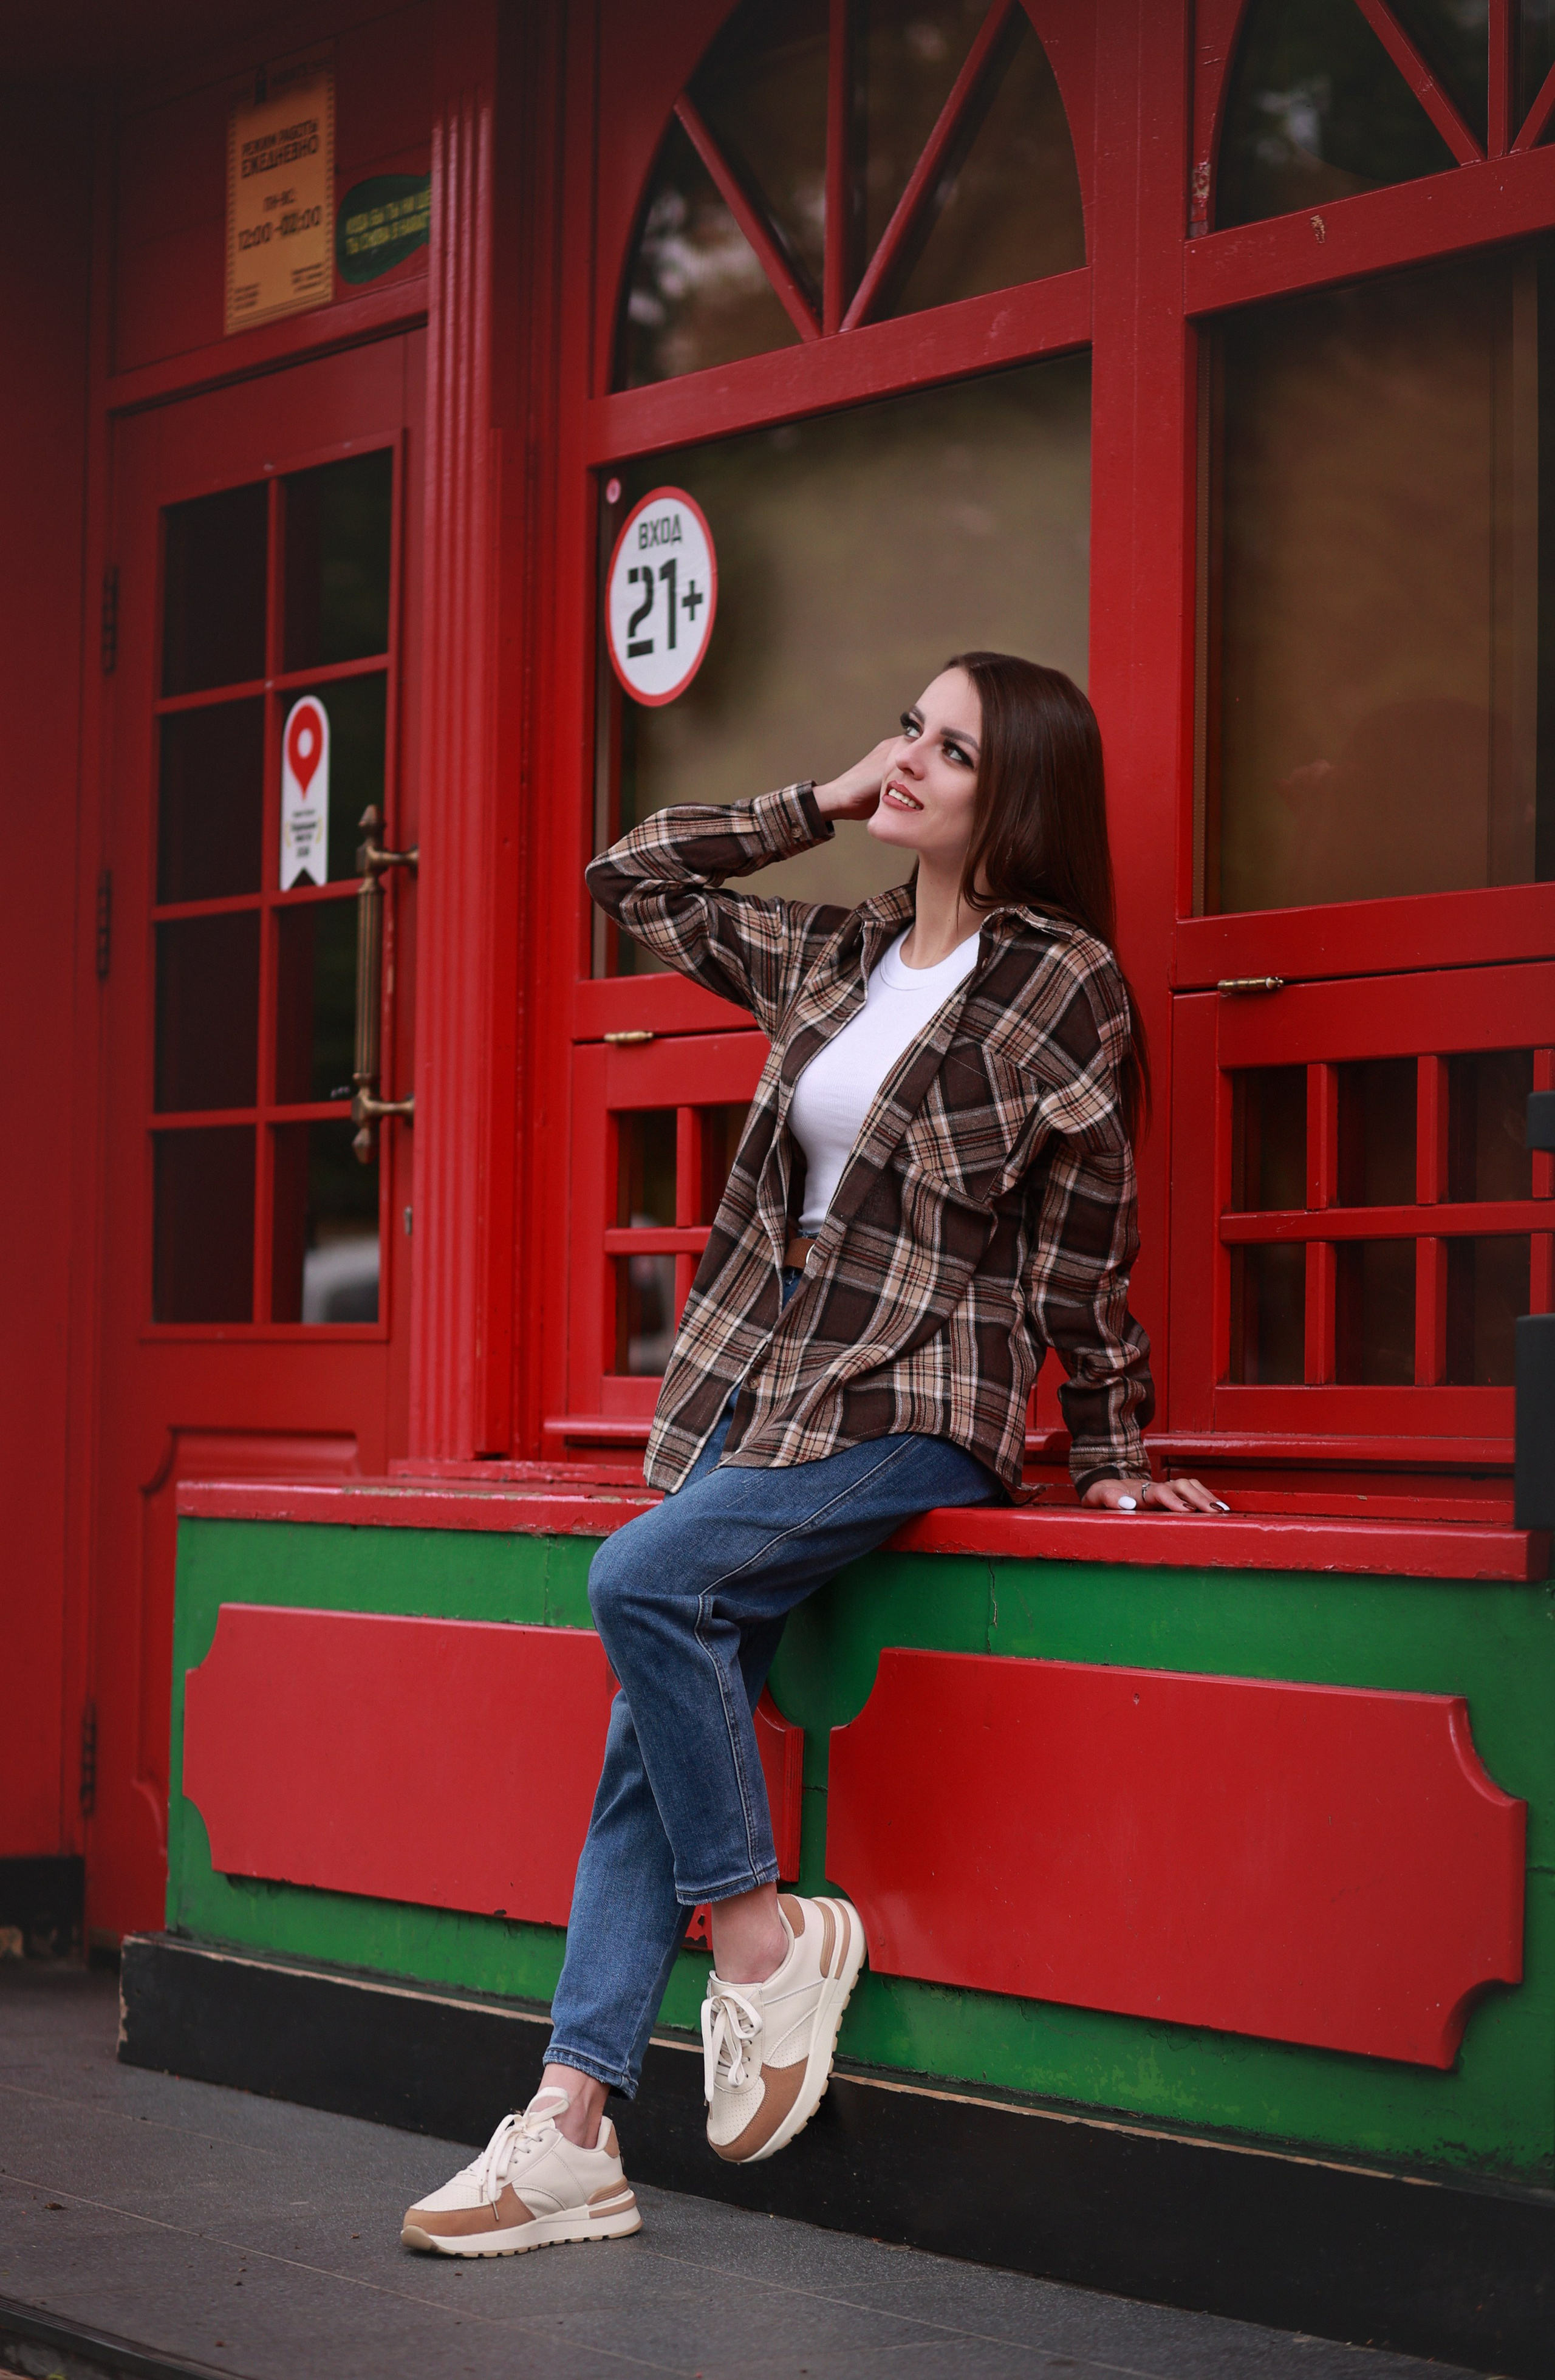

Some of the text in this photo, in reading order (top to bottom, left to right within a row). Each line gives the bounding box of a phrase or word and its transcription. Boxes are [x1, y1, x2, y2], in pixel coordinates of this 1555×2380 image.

[242, 134, 319, 178] ЕЖЕДНЕВНО
[638, 514, 682, 550] ВХОД
[627, 558, 703, 659] 21+
